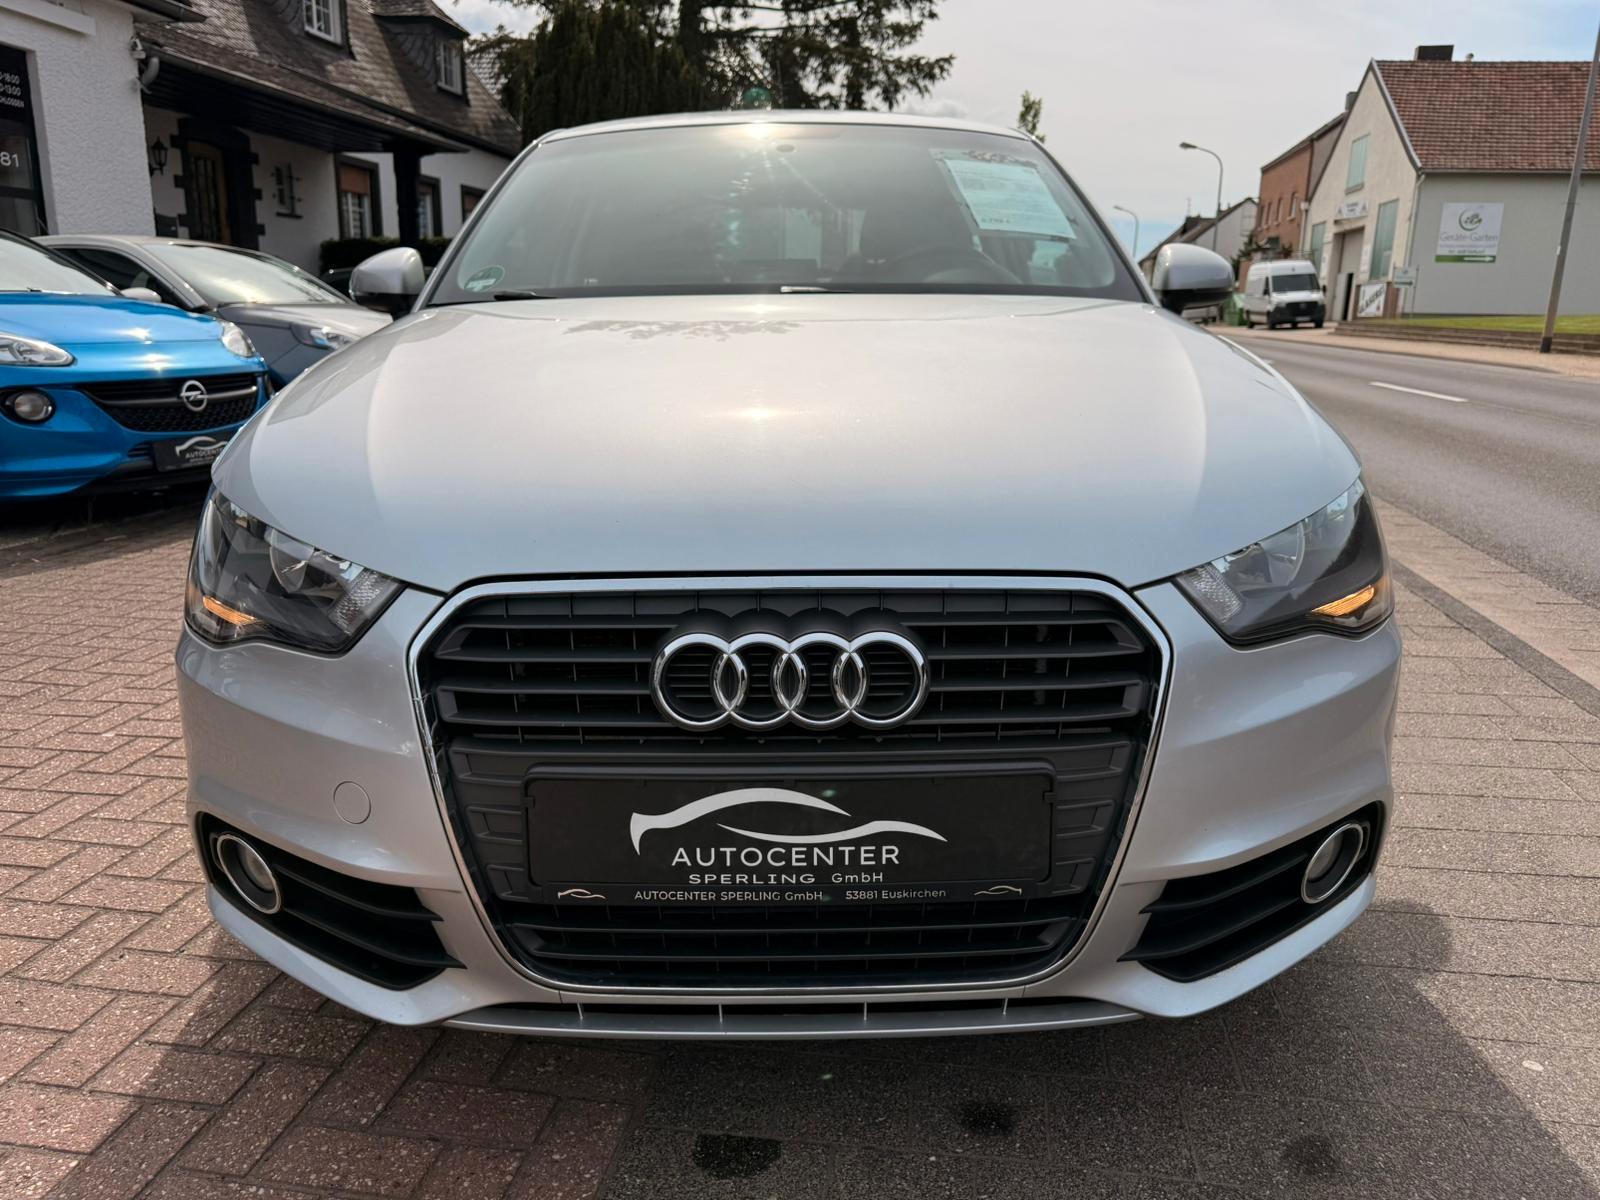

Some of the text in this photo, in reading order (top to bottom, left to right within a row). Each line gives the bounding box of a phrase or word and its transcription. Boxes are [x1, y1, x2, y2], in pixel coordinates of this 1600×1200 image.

[671, 845, 900, 867] AUTOCENTER
[688, 872, 883, 884] SPERLING GmbH
[634, 888, 947, 901] AUTOCENTER SPERLING GmbH 53881 Euskirchen
